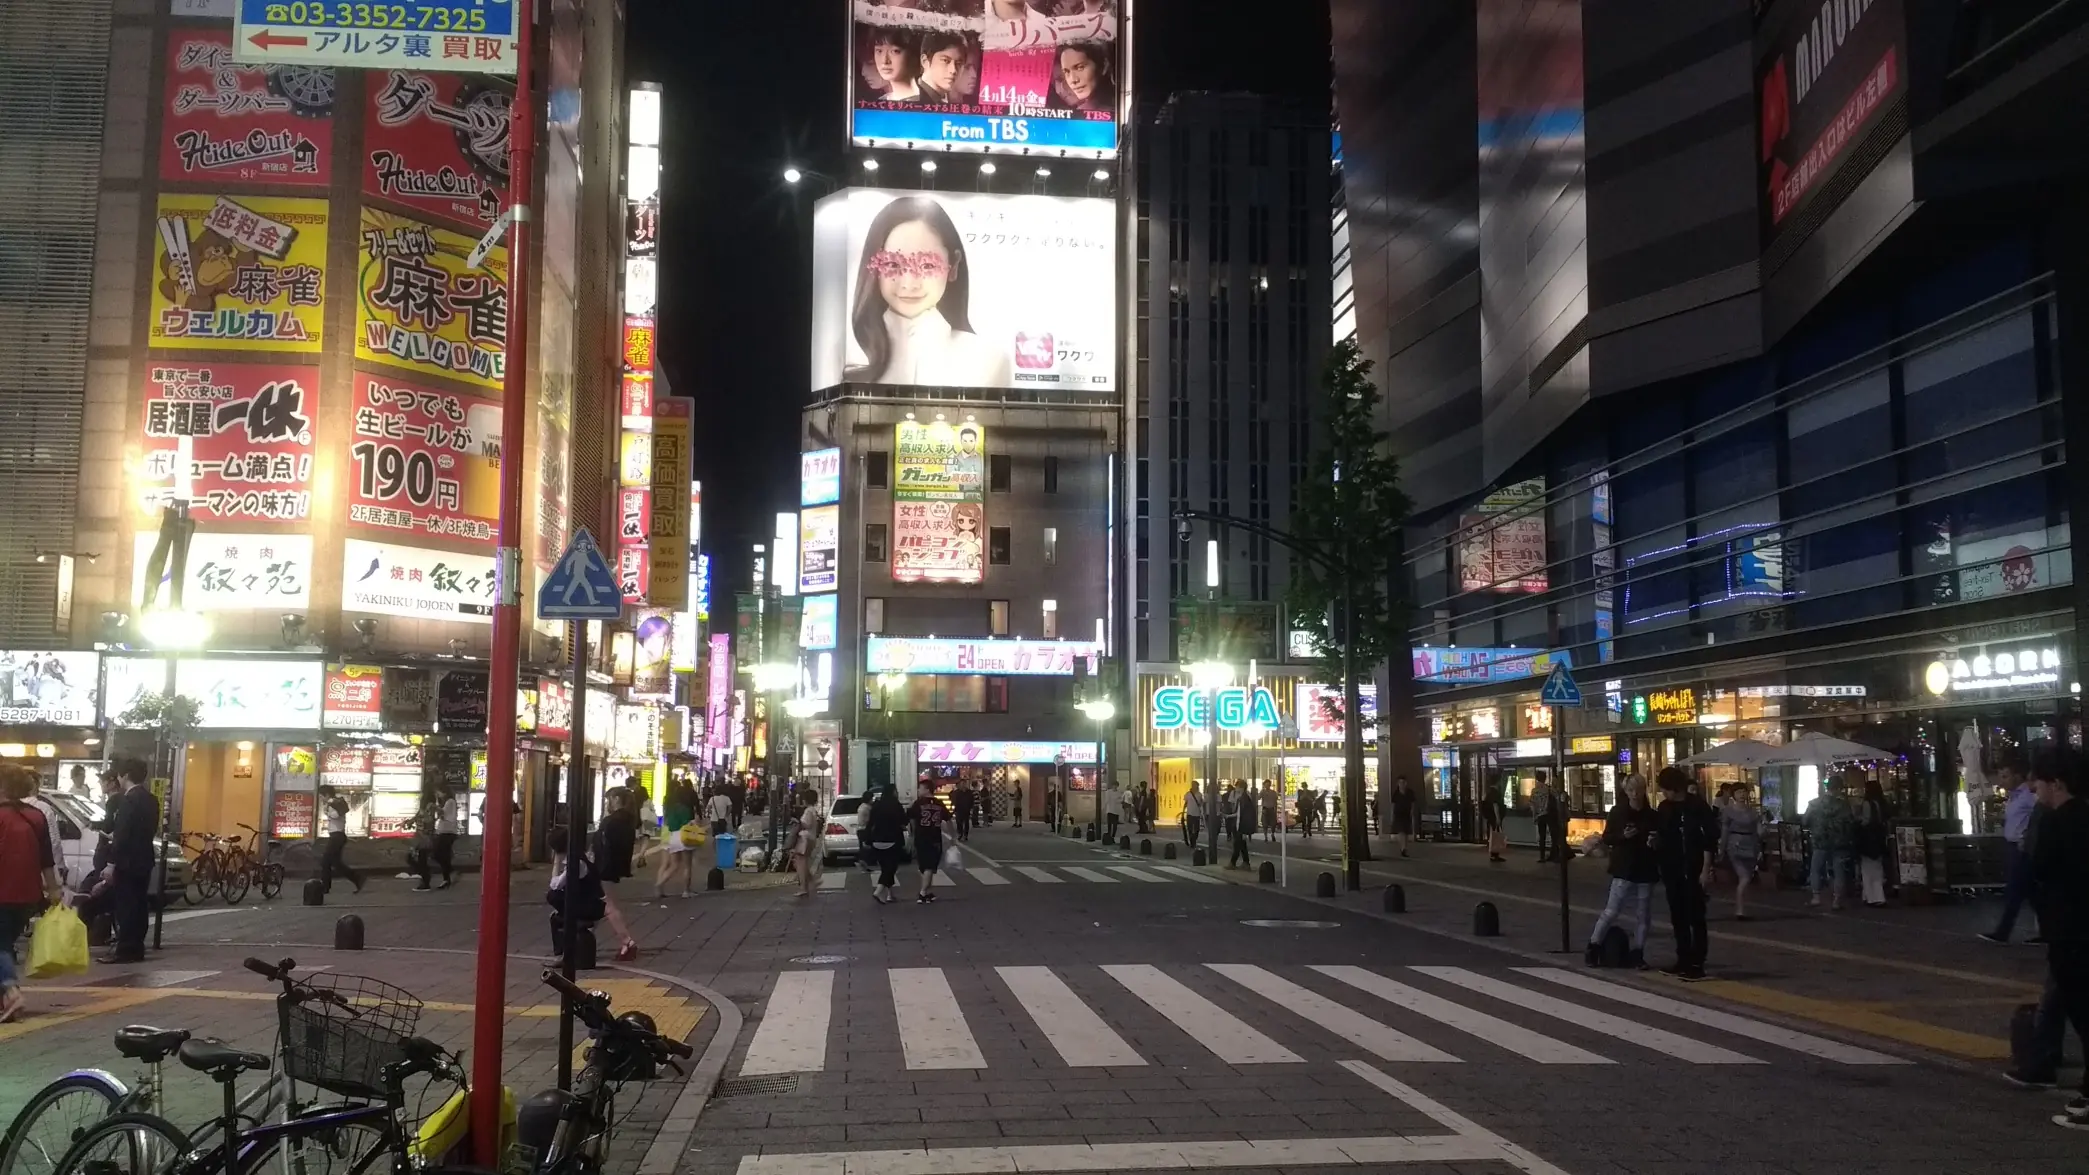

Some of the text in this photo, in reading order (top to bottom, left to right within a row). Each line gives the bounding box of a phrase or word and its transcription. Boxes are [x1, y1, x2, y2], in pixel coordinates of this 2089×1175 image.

[290, 2, 486, 31] 03-3352-7325
[1008, 14, 1112, 49] リバース
[314, 32, 501, 60] アルタ裏 買取
[217, 71, 237, 88] &
[175, 90, 288, 115] ダーツバー
[858, 100, 1003, 115] すべてをリバースする圧巻の結末
[1084, 111, 1112, 120] TBS
[942, 118, 1029, 141] From TBS
[211, 204, 281, 251] 低料金
[635, 205, 648, 241] ダーツ
[477, 235, 495, 257] 4m
[230, 265, 322, 305] 麻雀
[372, 258, 507, 345] 麻雀
[366, 321, 505, 374] WELCOME
[627, 328, 652, 364] 麻雀
[153, 369, 211, 382] 東京で一番
[163, 385, 234, 399] 旨くて安い店
[369, 383, 463, 421] いつでも
[147, 383, 307, 441] 居酒屋 一休
[356, 409, 473, 450] 生ビールが
[900, 443, 957, 454] 高収入求人
[804, 455, 838, 478] カラオケ
[653, 434, 678, 535] 高価買取
[900, 505, 926, 517] 女性
[898, 519, 955, 531] 高収入求人
[196, 560, 302, 595] 叙々苑
[390, 565, 423, 582] 焼肉
[354, 593, 454, 612] YAKINIKU JOJOEN
[958, 643, 974, 669] 24
[977, 659, 1005, 670] OPEN
[1154, 686, 1280, 730] SEGA
[1649, 688, 1696, 711] 長崎ちゃんぽん
[0, 708, 81, 721] 5287-1081
[1657, 712, 1690, 723] リンガーハット
